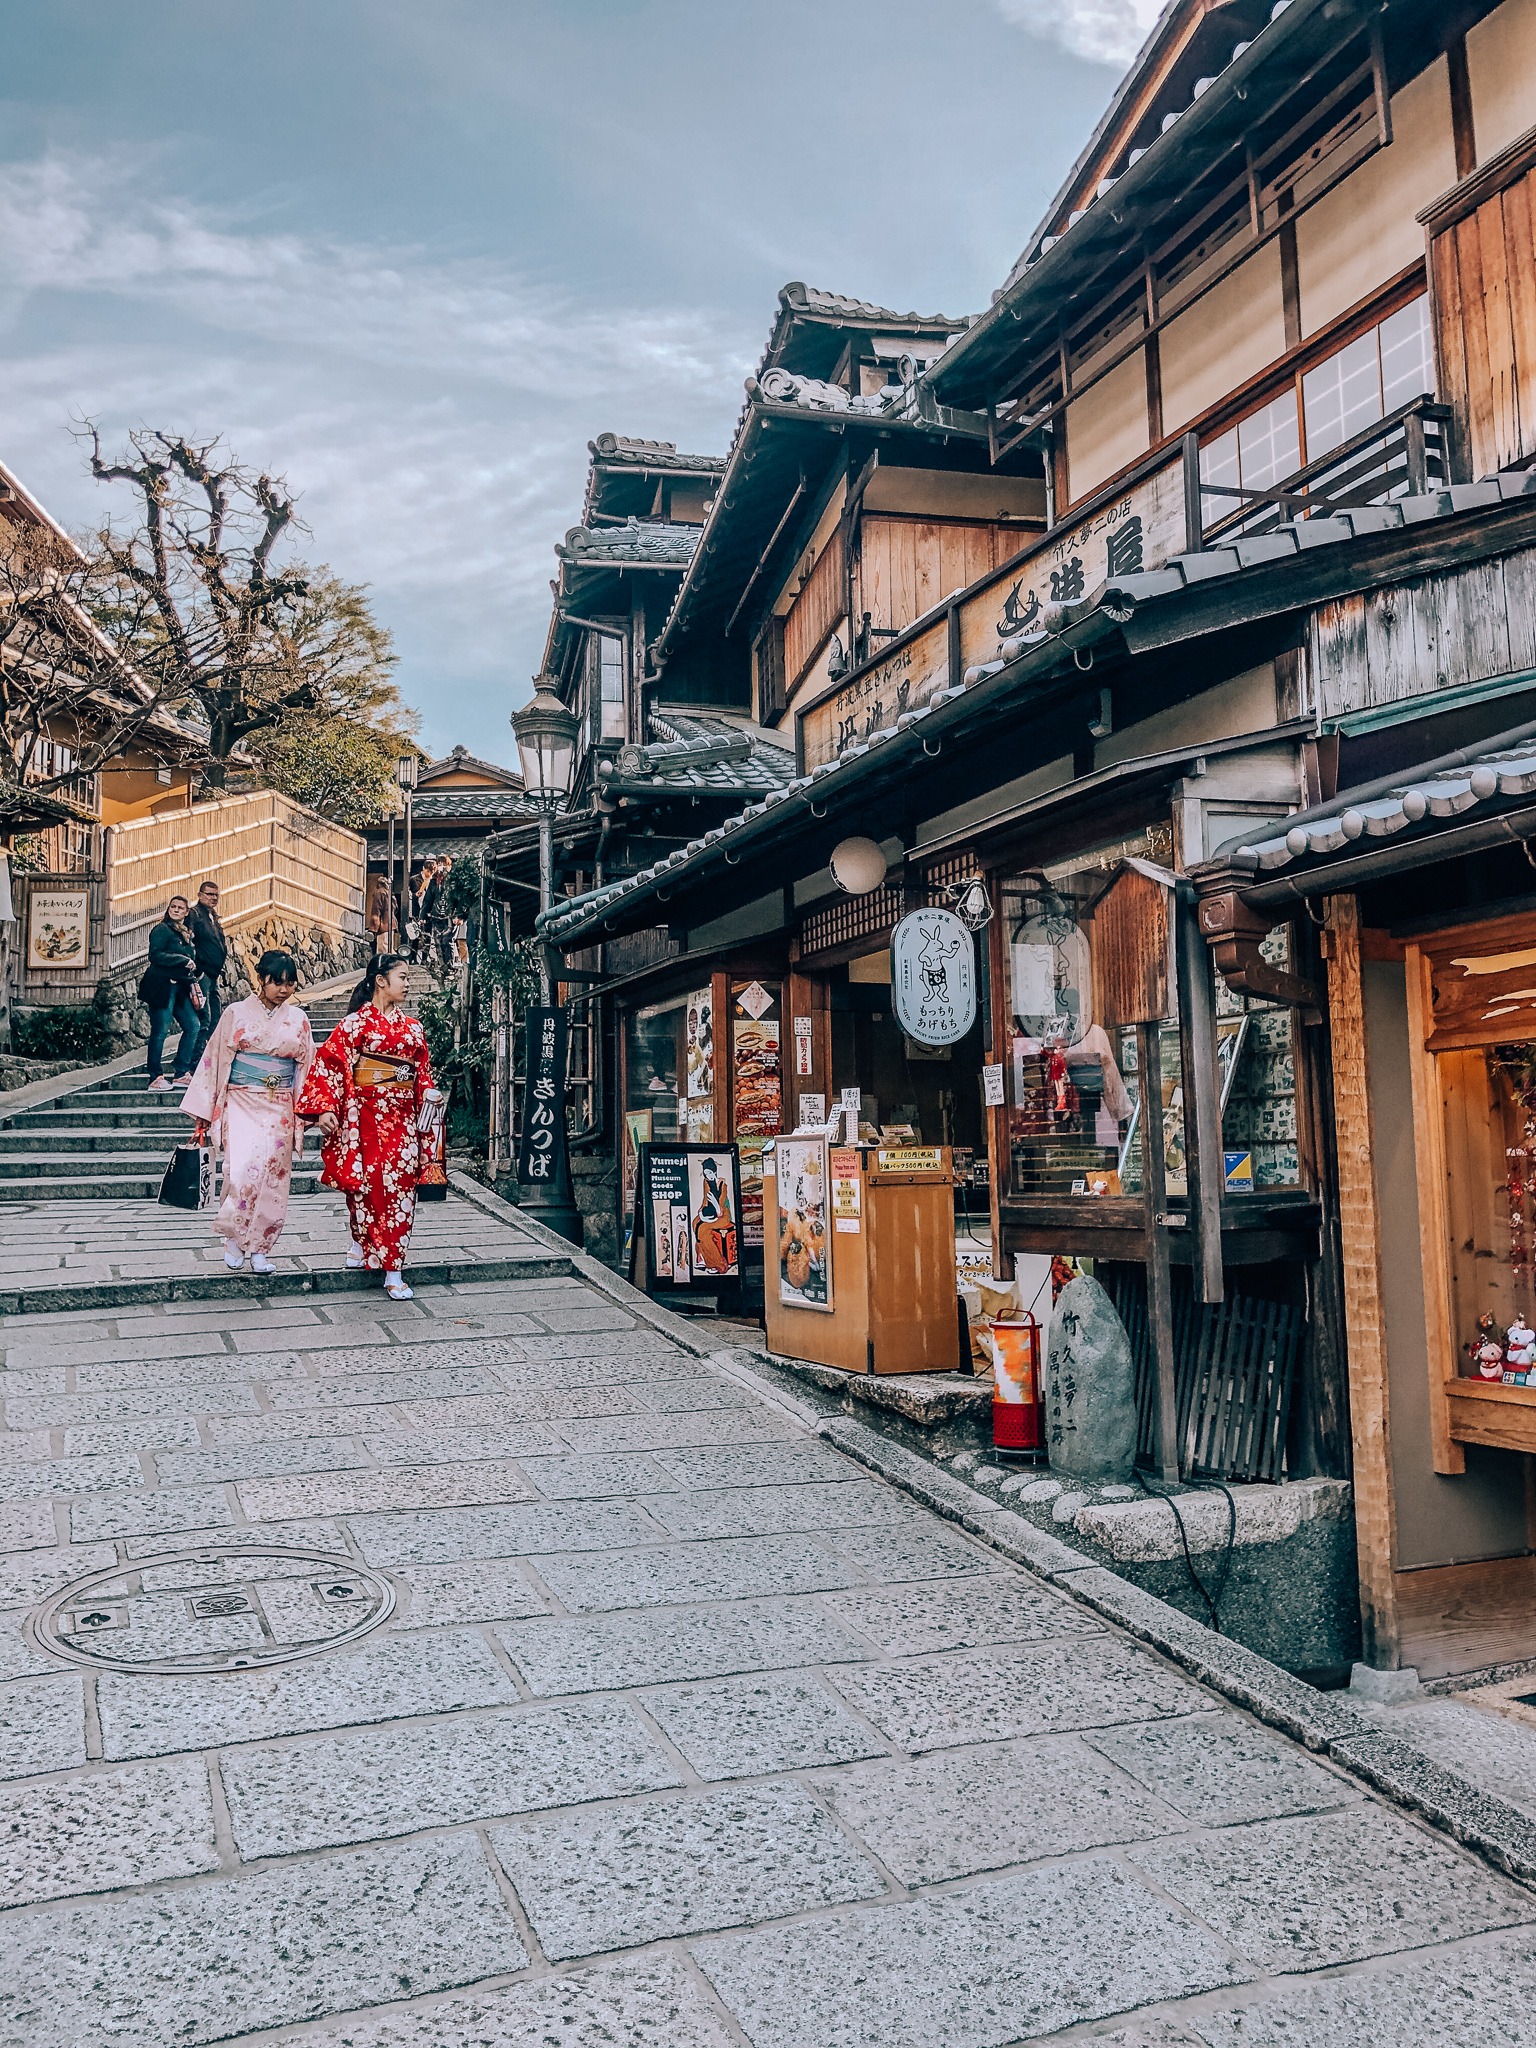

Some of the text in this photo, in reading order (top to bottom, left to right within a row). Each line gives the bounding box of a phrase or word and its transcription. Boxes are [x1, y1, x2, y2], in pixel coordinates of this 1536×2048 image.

[1053, 497, 1132, 562] 竹久夢二の店
[836, 645, 912, 713] 丹波黒豆きんつば
[919, 1005, 954, 1018] もっちり
[917, 1018, 957, 1031] あげもち
[651, 1157, 688, 1167] Yumeji
[652, 1191, 683, 1200] SHOP
[1062, 1310, 1081, 1432] 竹久夢二
